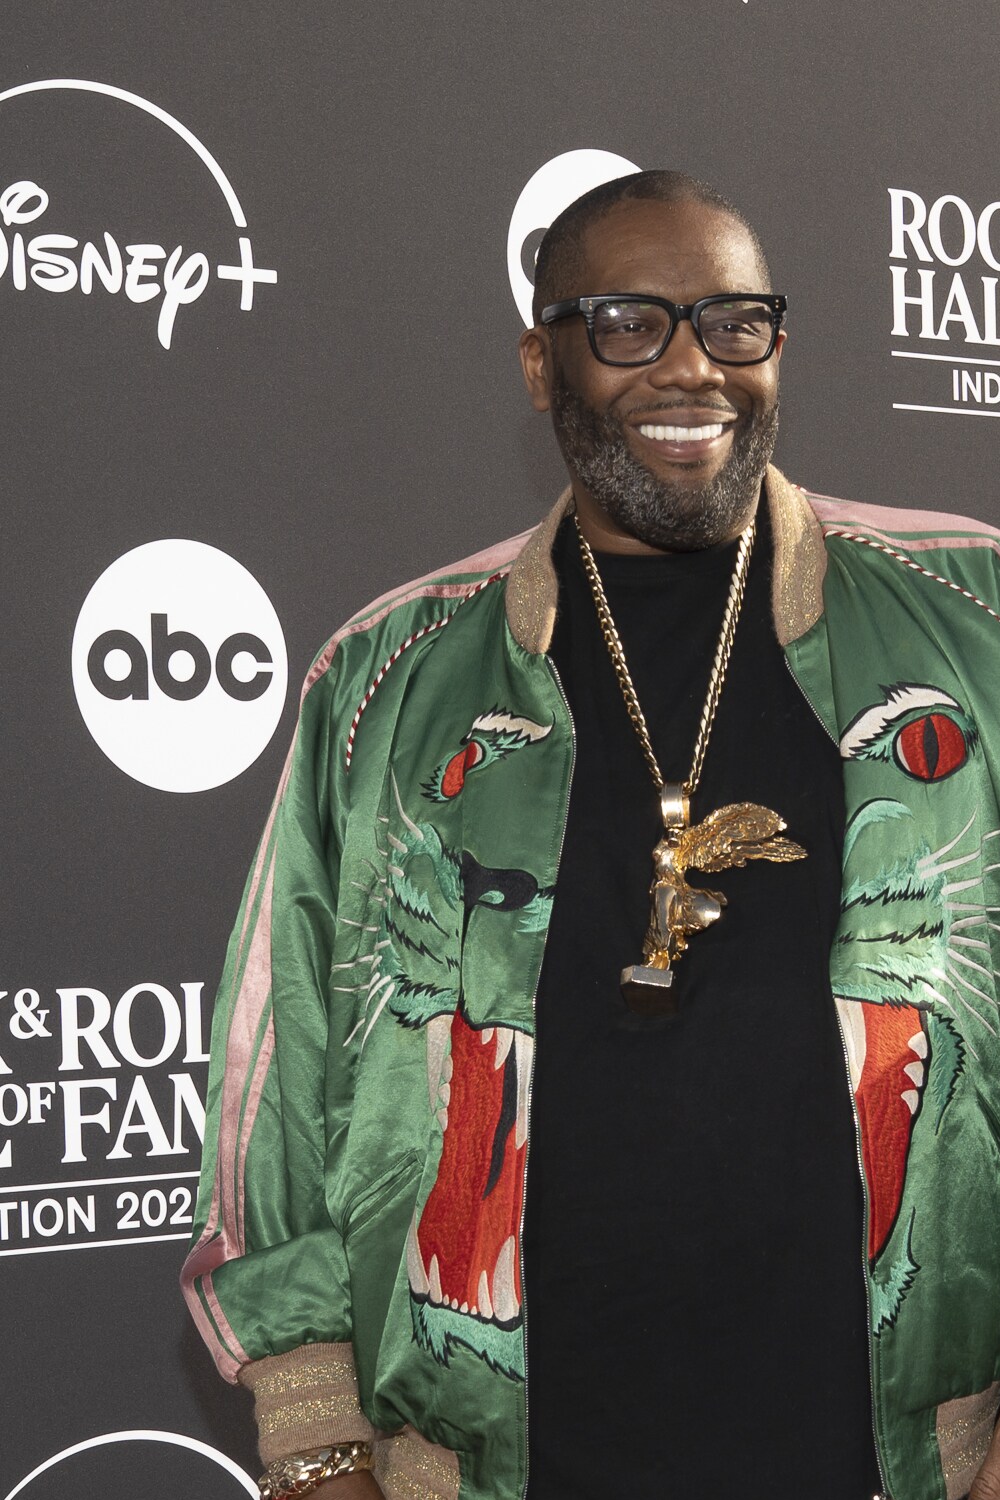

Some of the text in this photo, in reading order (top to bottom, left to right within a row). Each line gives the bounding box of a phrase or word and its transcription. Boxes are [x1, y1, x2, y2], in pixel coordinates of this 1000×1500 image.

[0, 180, 278, 350] isney+
[87, 612, 274, 702] abc
[116, 1186, 201, 1230] 202
